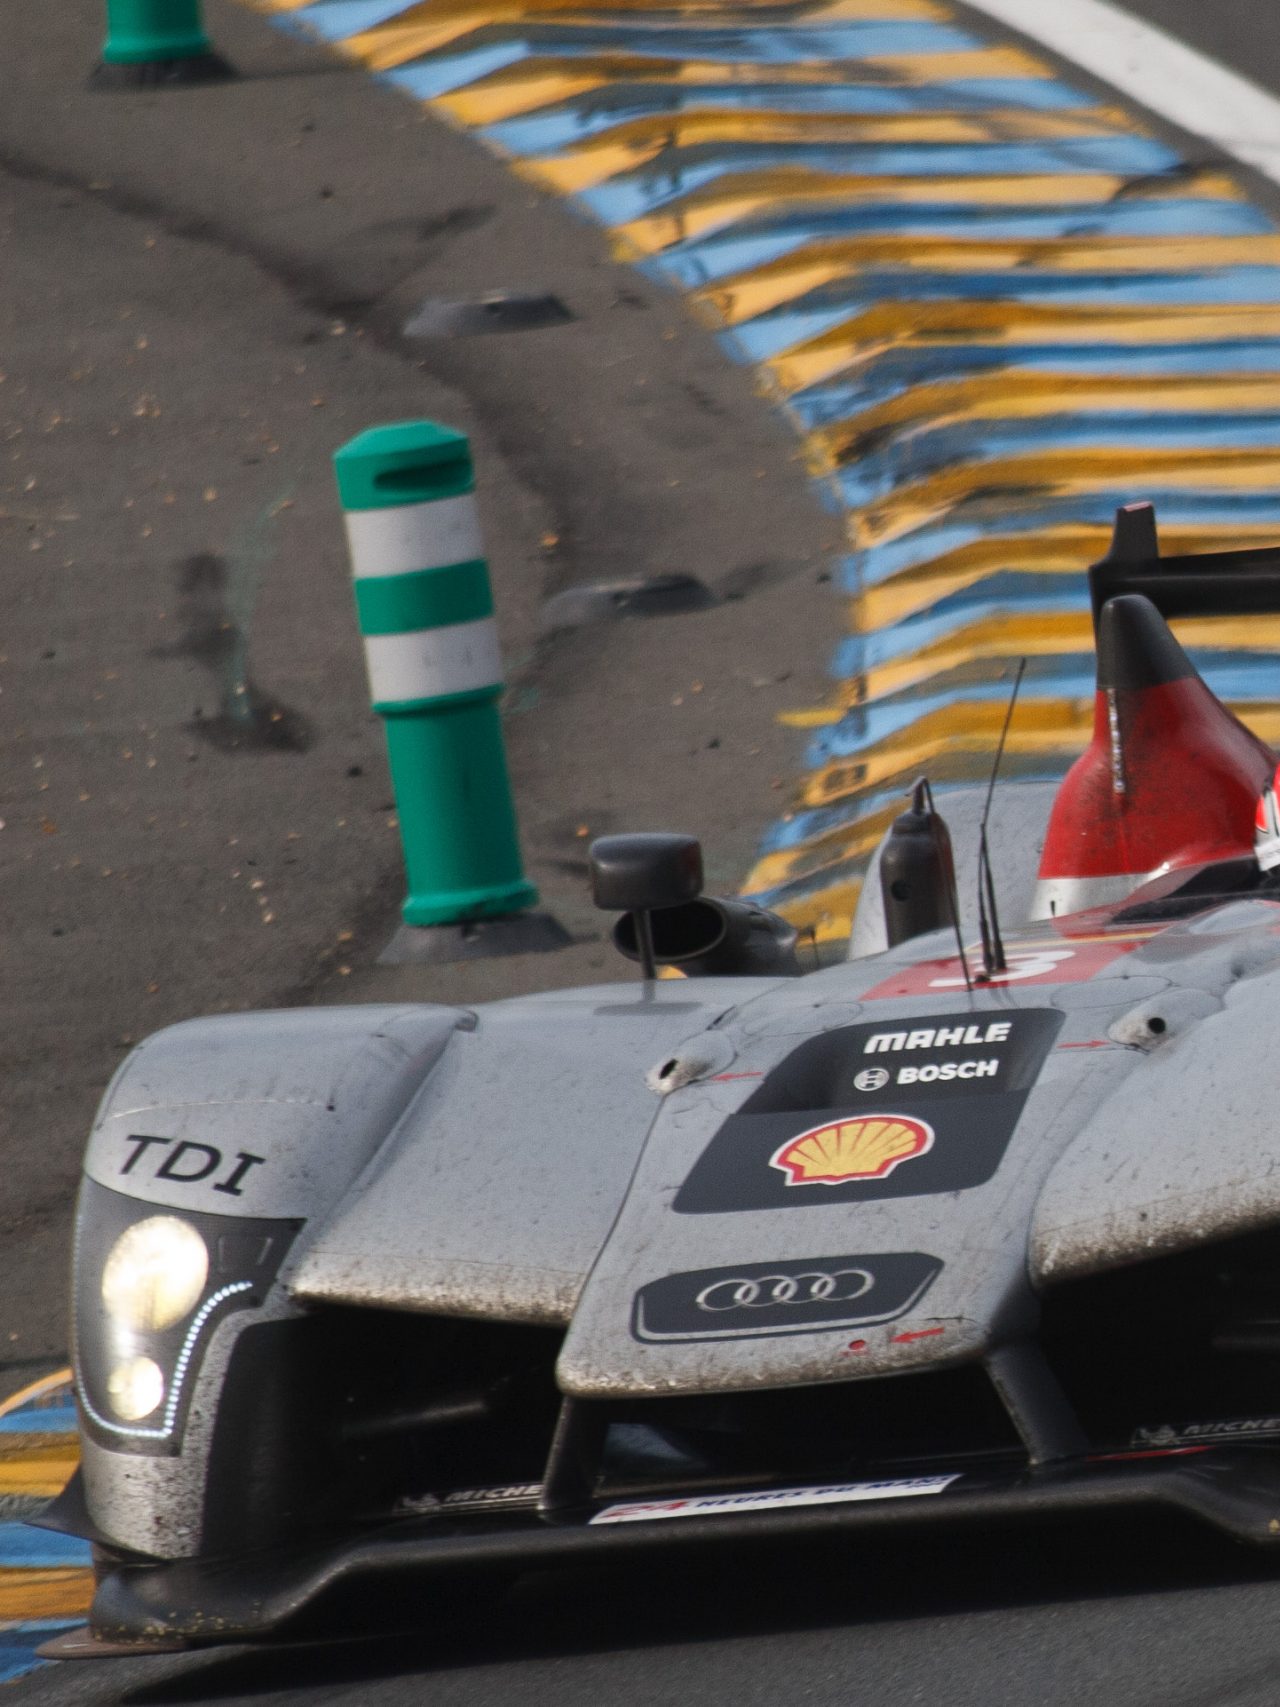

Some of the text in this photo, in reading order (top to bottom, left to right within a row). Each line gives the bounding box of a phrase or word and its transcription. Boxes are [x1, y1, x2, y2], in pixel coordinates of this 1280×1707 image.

[863, 1022, 1012, 1055] MAHLE
[897, 1059, 999, 1085] BOSCH
[119, 1134, 266, 1197] TDI
[444, 1484, 543, 1502] MICHE
[598, 1500, 689, 1520] 24
